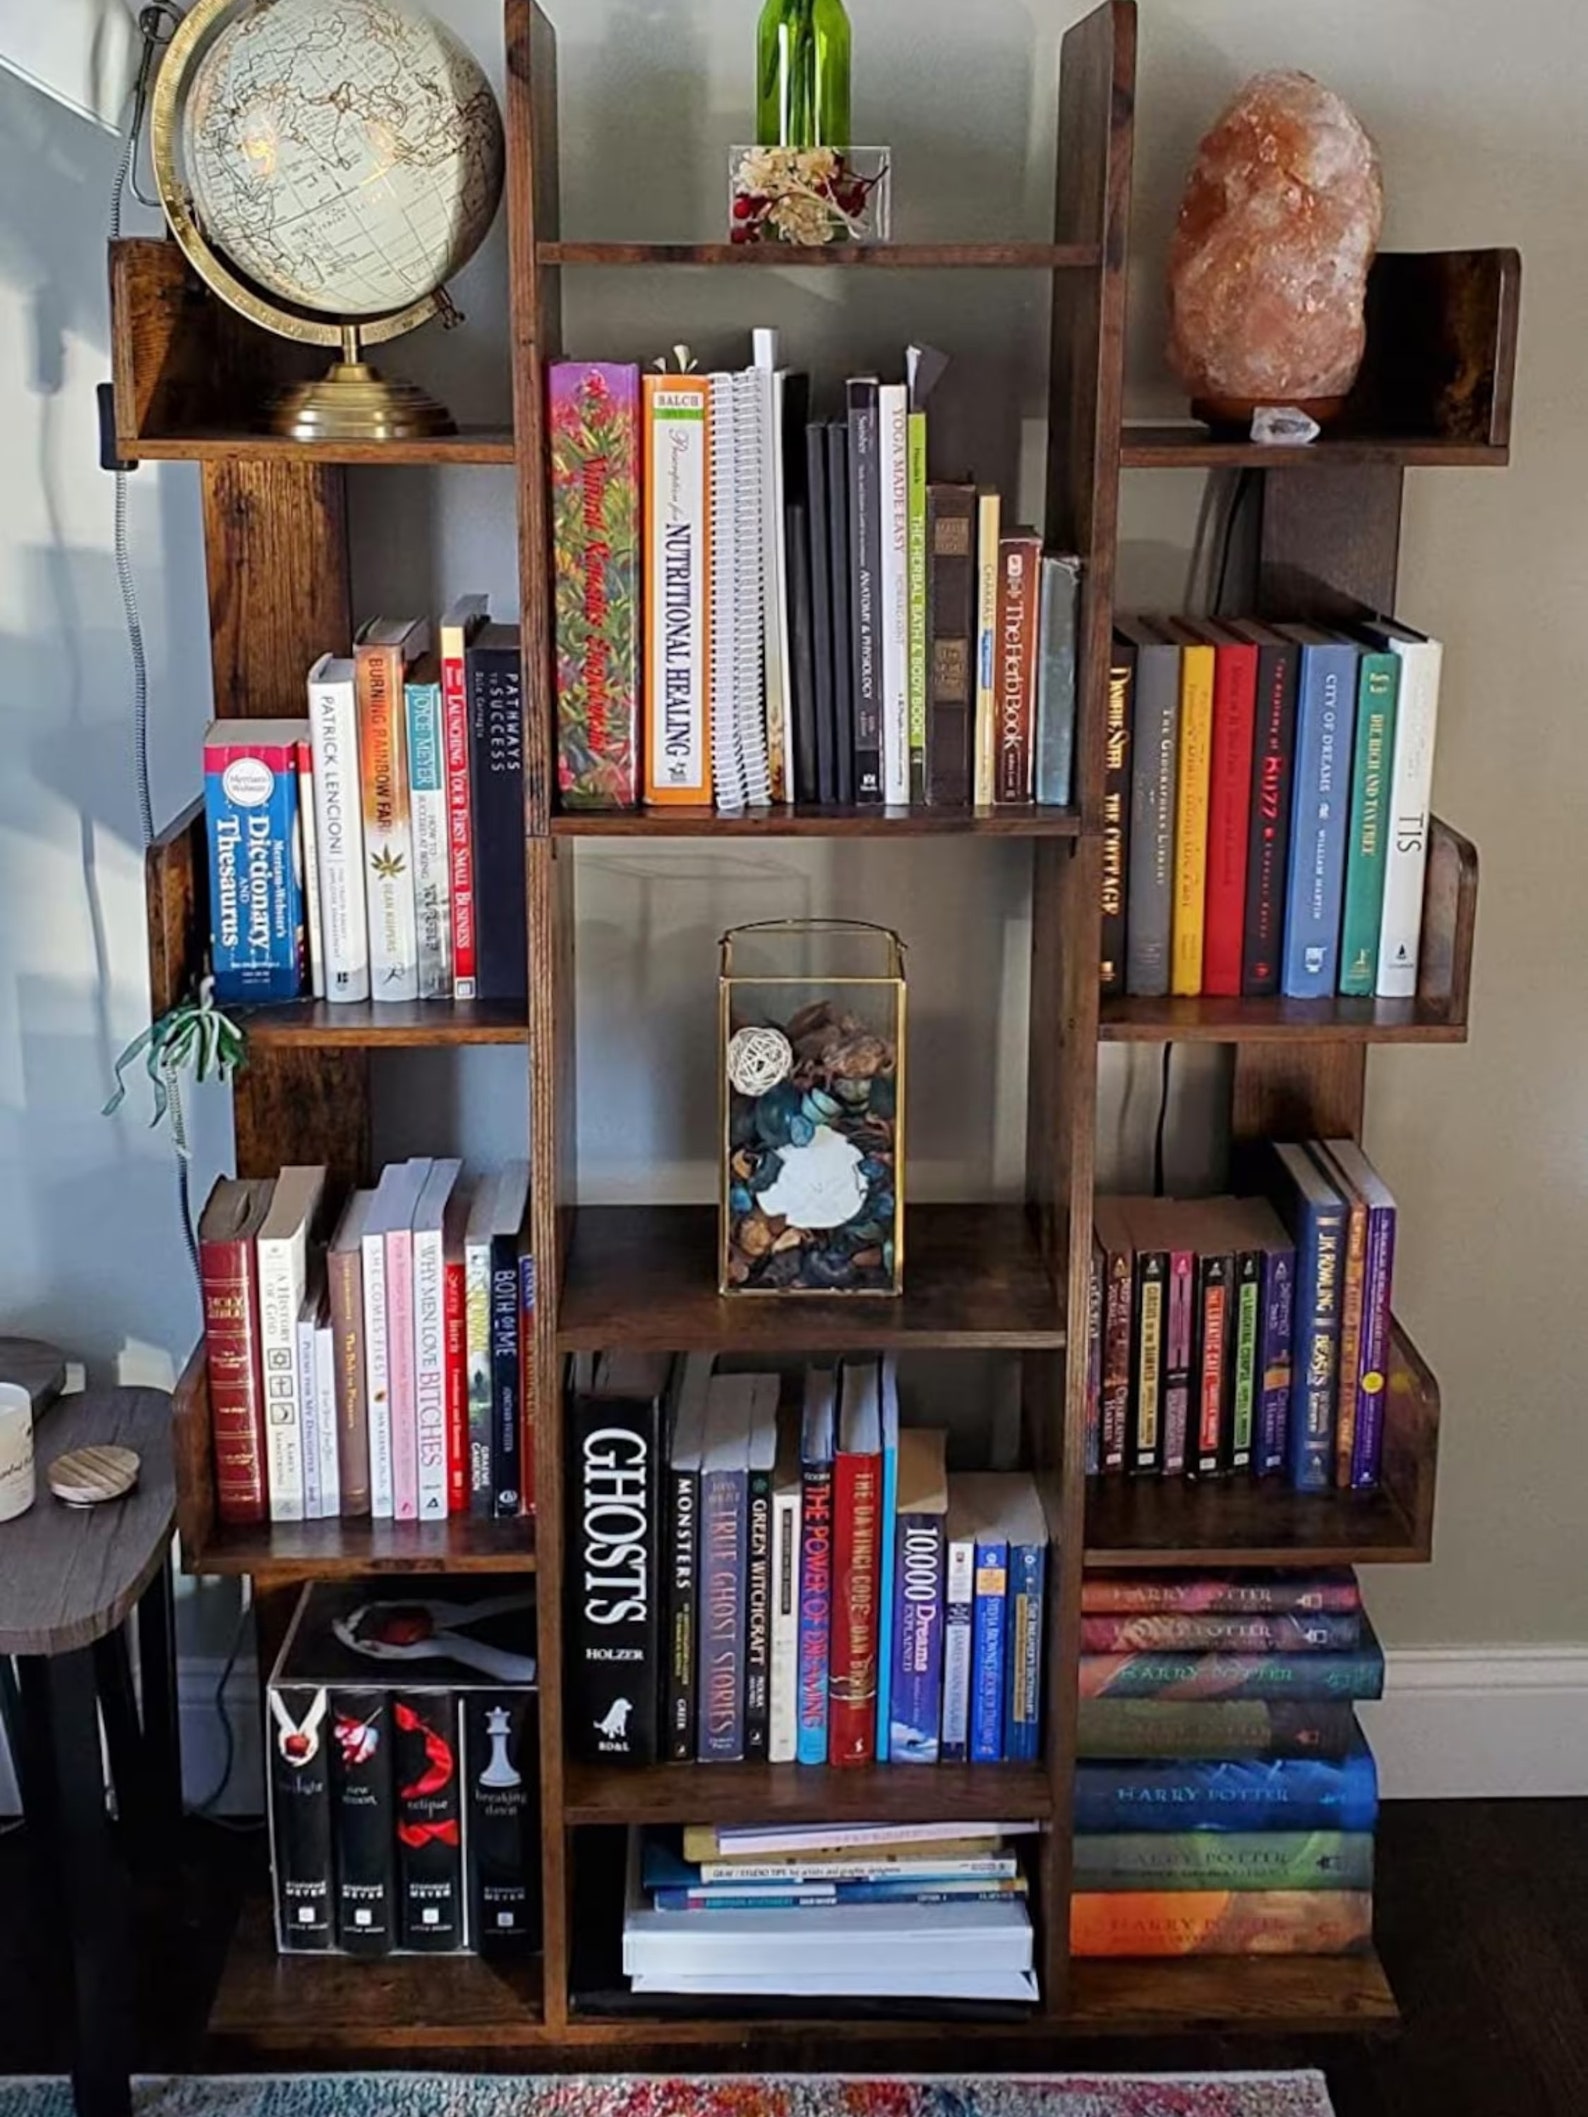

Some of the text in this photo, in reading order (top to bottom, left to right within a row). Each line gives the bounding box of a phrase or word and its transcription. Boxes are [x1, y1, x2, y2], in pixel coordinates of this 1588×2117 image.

[657, 394, 699, 407] BALCH
[892, 407, 907, 553] YOGA MADE EASY
[666, 522, 692, 663] NUTRITIONAL
[860, 570, 872, 622] ANATOMY
[861, 624, 873, 634] &
[910, 515, 924, 738] THE HERBAL BATH & BODY BOOK
[861, 635, 874, 699] PHYSIOLOGY
[411, 690, 436, 786] JOYCE MEYER
[490, 687, 505, 772] SUCCESS
[506, 673, 521, 771] PATHWAYS
[666, 667, 692, 757] HEALING
[1319, 674, 1339, 792] CITY OF DREAMS
[321, 696, 343, 855] PATRICK LENCIONI
[370, 657, 392, 840] BURNING RAINBOW FAR
[1367, 738, 1383, 770] RICH
[1365, 773, 1381, 798] AND
[448, 694, 472, 949] LAUNCHING YOUR FIRST SMALL BUSINESS
[1361, 823, 1377, 857] FREE
[216, 814, 241, 947] Thesaurus
[240, 876, 252, 903] AND
[247, 815, 273, 951] Dictionary
[272, 839, 287, 938] Merriam-Webster's
[1102, 827, 1121, 916] COTTAGE
[1312, 828, 1326, 919] WILLIAM MARTIN
[371, 1281, 387, 1334] COMES
[495, 1269, 517, 1312] BOTH
[1316, 1253, 1335, 1311] ROWLING
[265, 1301, 279, 1335] GOD
[279, 1285, 292, 1342] HISTORY
[373, 1341, 387, 1378] FIRST
[419, 1244, 443, 1467] WHY MEN LOVE BITCHES
[496, 1331, 517, 1357] ME
[1308, 1334, 1330, 1386] BEASTS
[470, 1441, 482, 1492] CAMERON
[479, 1445, 490, 1486] GRAEME
[854, 1472, 875, 1500] THE
[582, 1427, 648, 1626] GHOSTS
[804, 1483, 830, 1520] THE
[852, 1505, 873, 1527] DA
[676, 1477, 693, 1589] MONSTERS
[710, 1508, 738, 1561] TRUE
[803, 1525, 829, 1592] POWER
[851, 1528, 873, 1570] VINCI
[710, 1572, 738, 1641] GHOST
[750, 1499, 768, 1665] GREEN WITCHCRAFT
[850, 1575, 872, 1613] CODE
[903, 1526, 939, 1672] 10,000 Dreams
[803, 1598, 828, 1626] OF
[850, 1624, 869, 1655] DAN
[903, 1602, 915, 1672] EXPLAINED
[585, 1647, 644, 1661] HOLZER
[801, 1630, 828, 1729] DREAMING
[1120, 1665, 1199, 1681] HARRY
[676, 1698, 687, 1729] GREER
[708, 1651, 737, 1733] STORIES
[1116, 1786, 1288, 1802] HARRY POTTER
